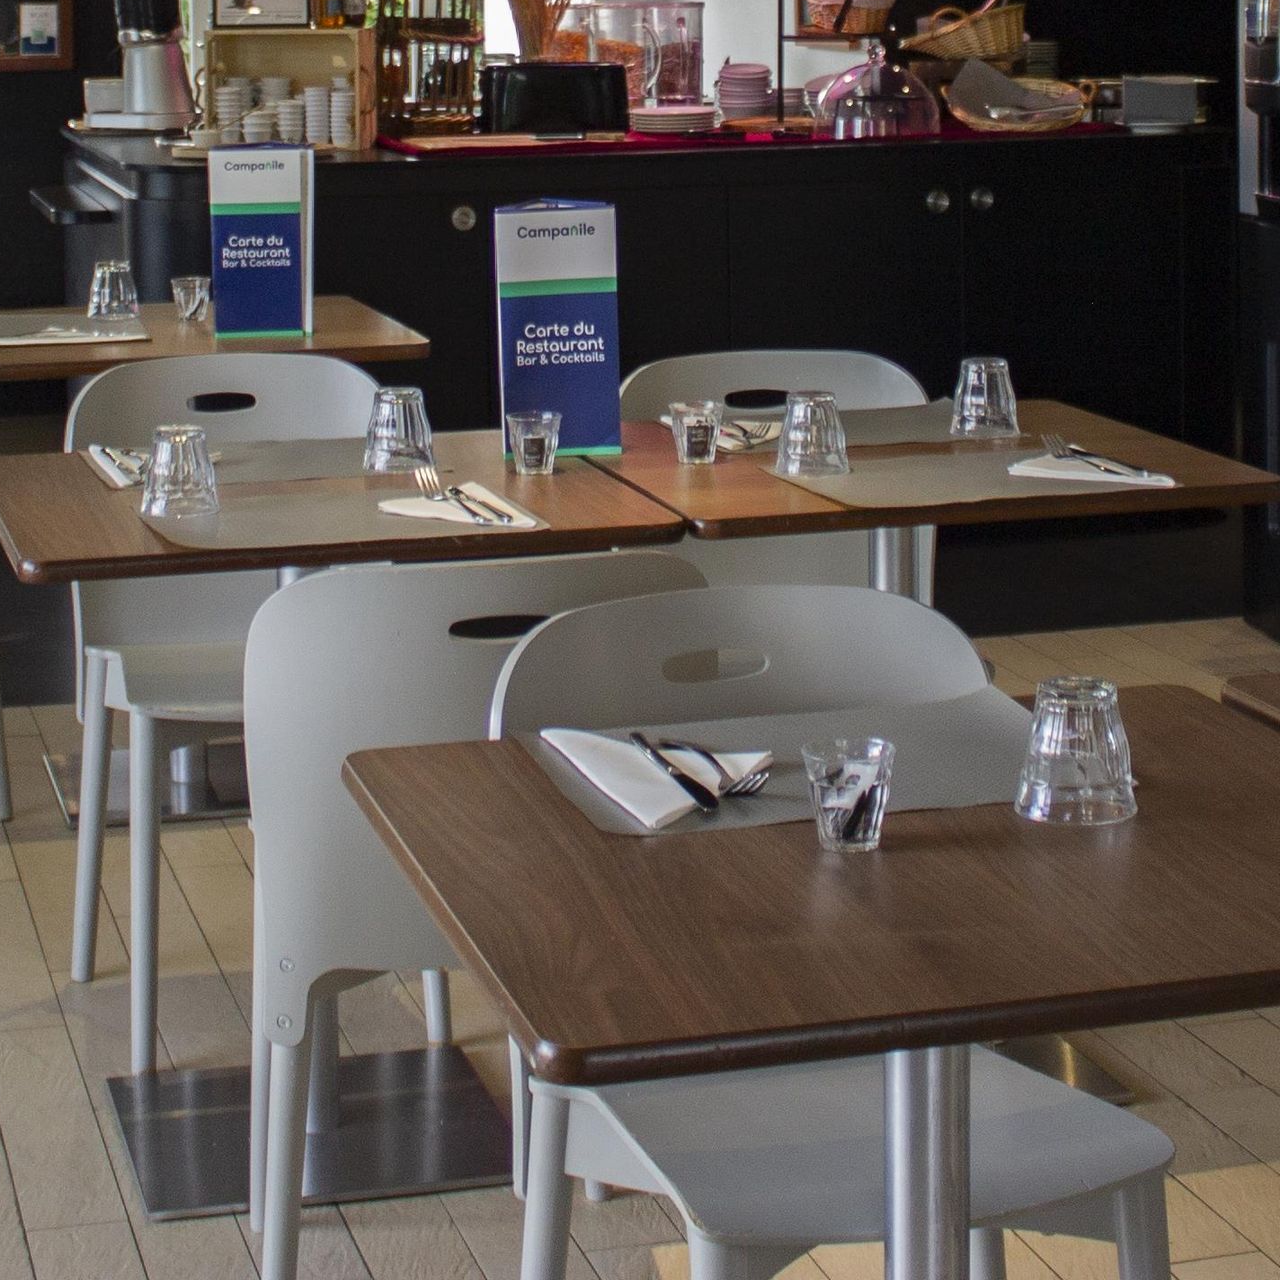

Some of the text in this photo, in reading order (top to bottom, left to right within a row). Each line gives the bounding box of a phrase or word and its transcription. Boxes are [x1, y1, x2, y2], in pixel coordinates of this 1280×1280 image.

[224, 160, 285, 173] Campanile
[517, 223, 596, 240] Campanile
[228, 235, 283, 247] Carte du
[222, 247, 291, 260] Restaurant
[222, 257, 291, 269] Bar & Cocktails
[524, 321, 595, 339] Carte du
[516, 337, 605, 355] Restaurant
[516, 351, 605, 367] Bar & Cocktails
